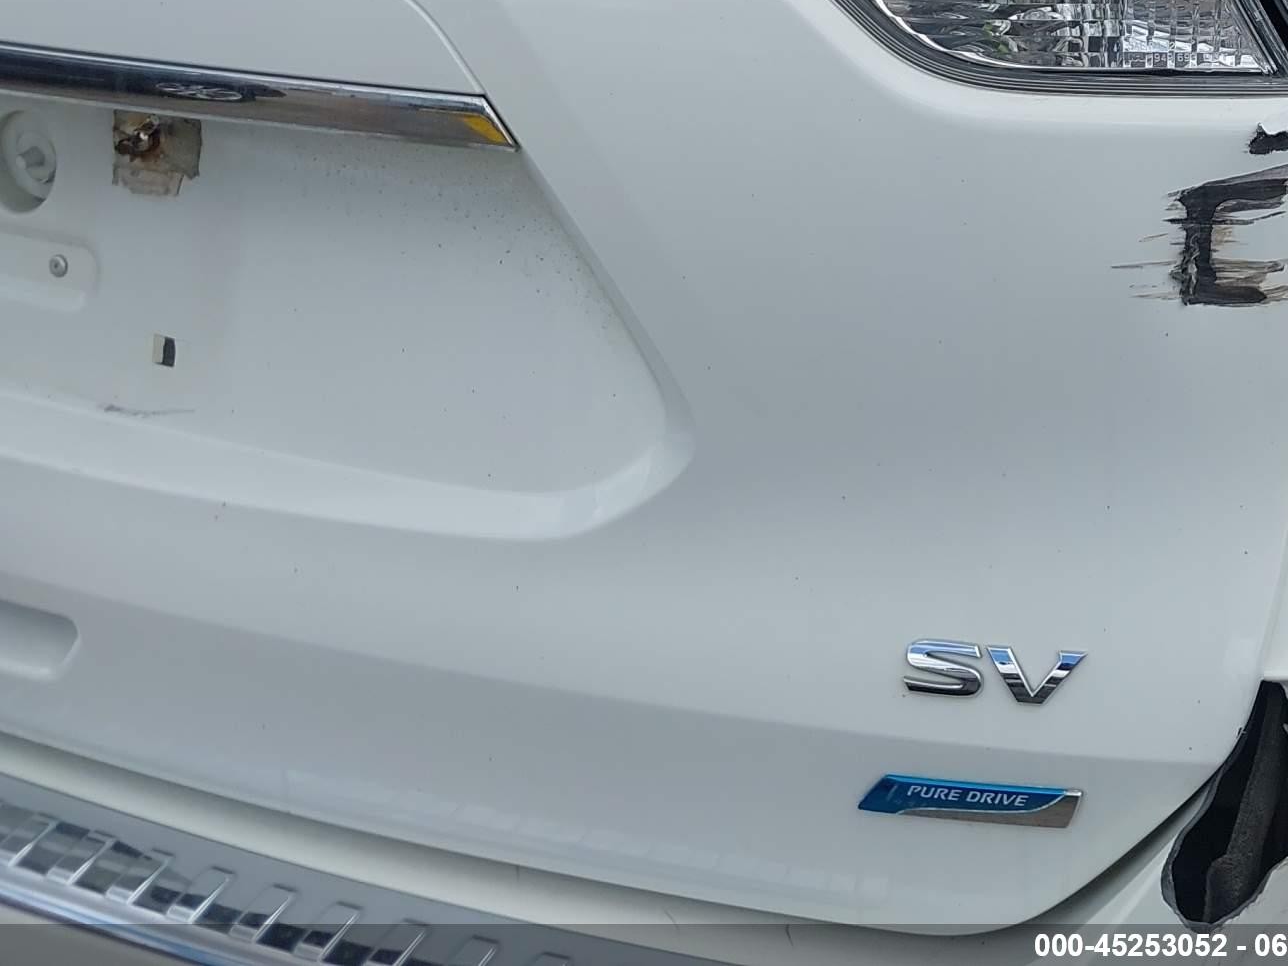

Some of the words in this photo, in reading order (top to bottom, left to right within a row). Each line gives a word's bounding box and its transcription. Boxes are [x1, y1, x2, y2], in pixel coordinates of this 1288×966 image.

[903, 638, 1088, 705] SV
[906, 785, 963, 801] PURE
[965, 791, 1029, 807] DRIVE
